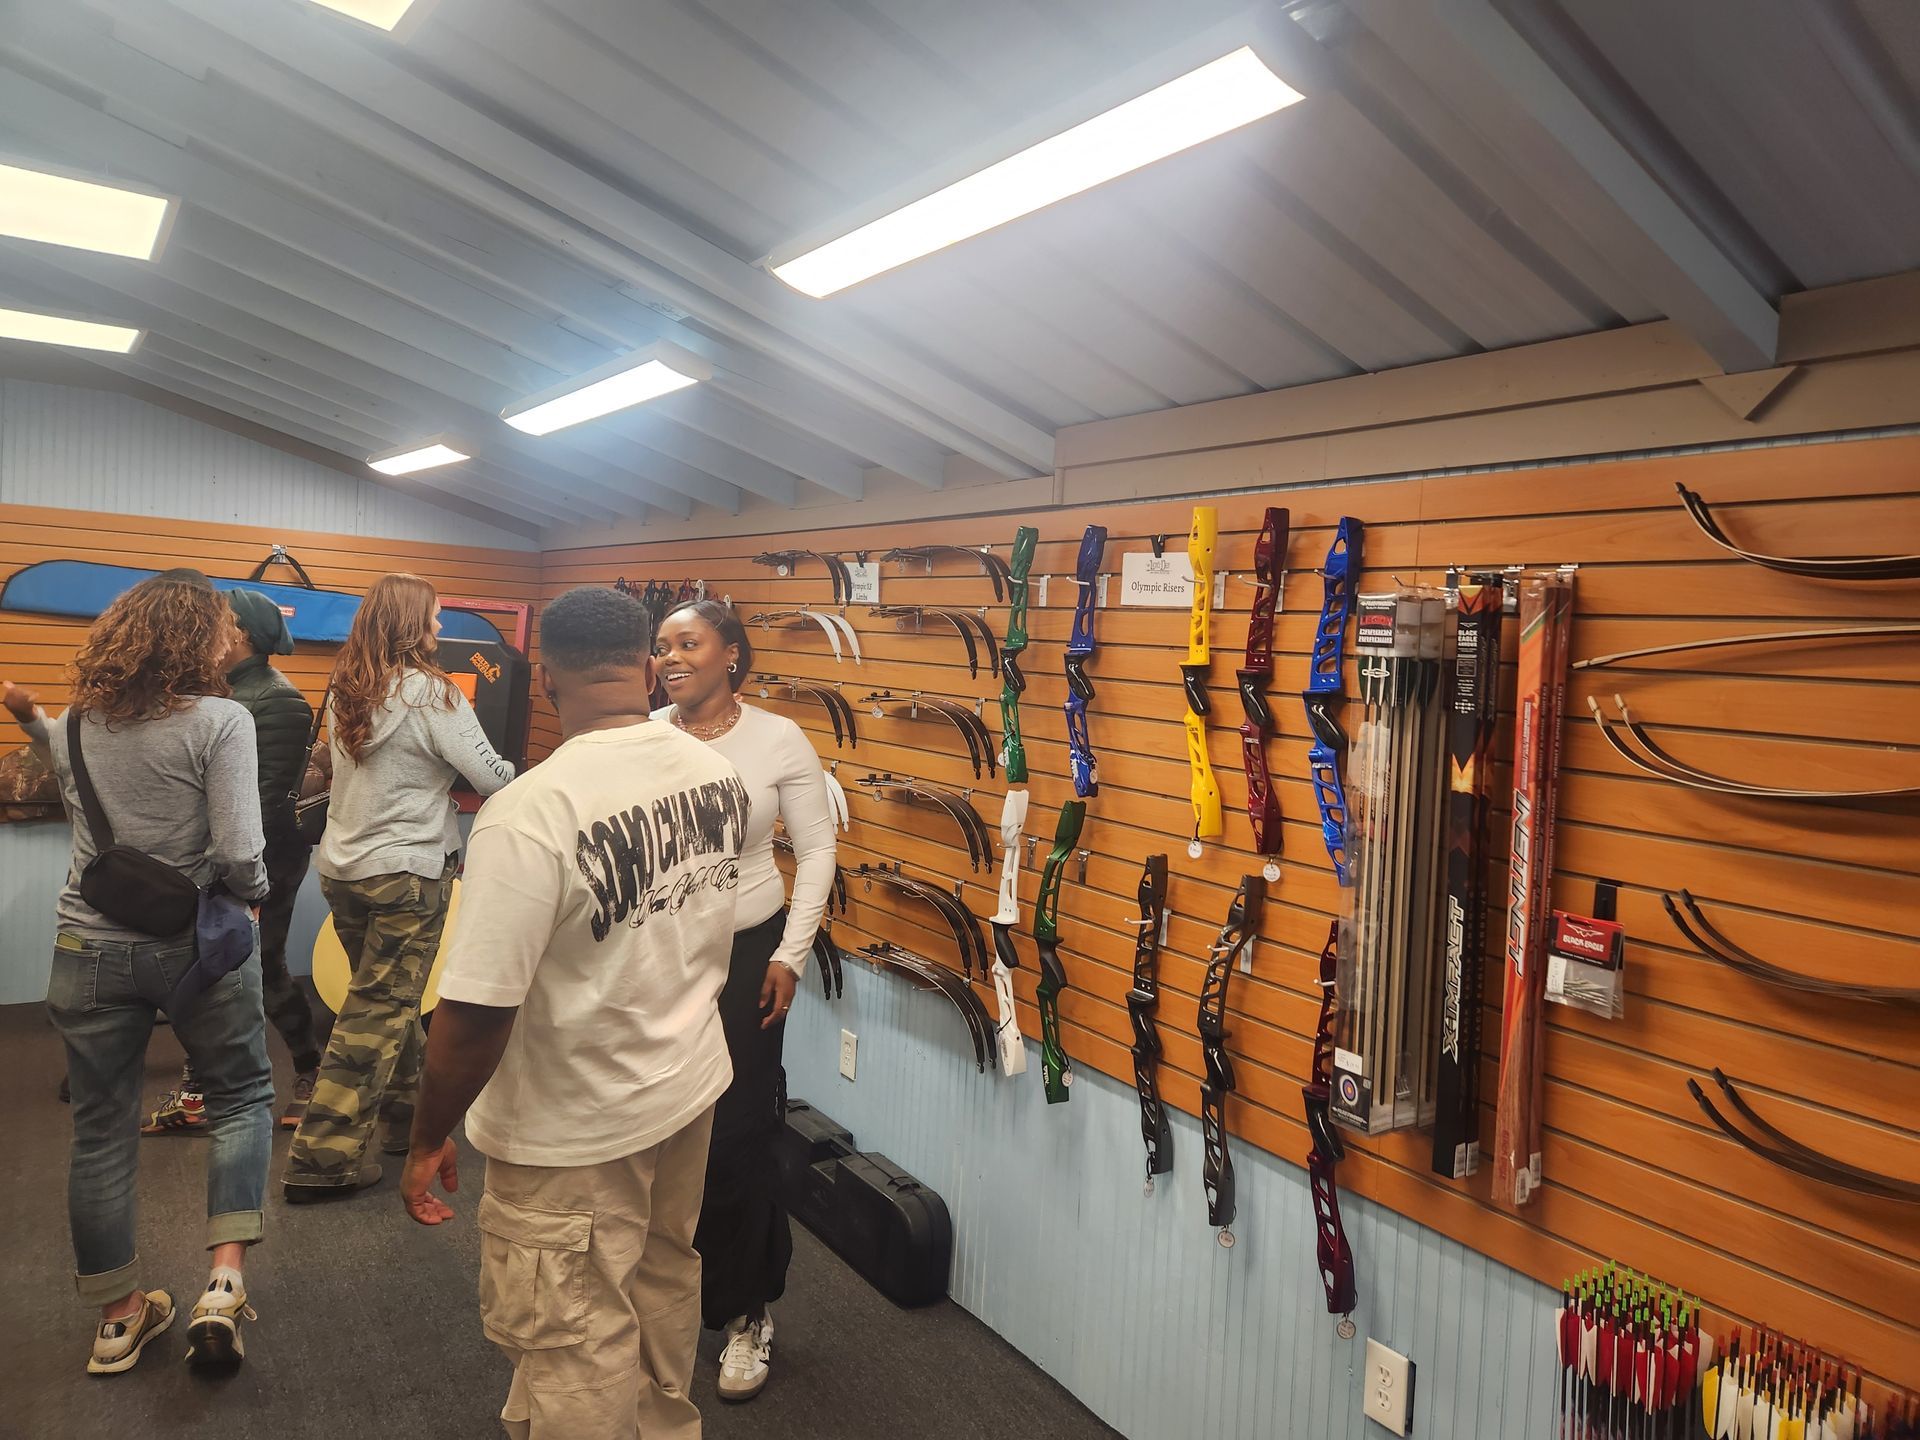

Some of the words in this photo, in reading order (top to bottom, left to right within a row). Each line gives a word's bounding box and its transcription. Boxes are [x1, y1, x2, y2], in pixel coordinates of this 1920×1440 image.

[1131, 581, 1162, 594] Olympic
[1163, 583, 1185, 593] Risers
[1457, 635, 1478, 643] EAGLE
[576, 804, 655, 943] SOHO
[1507, 787, 1531, 979] INSTINCT
[1442, 894, 1464, 1065] X-IMPACT
[1562, 934, 1585, 946] BLACK
[1584, 940, 1605, 953] EAGLE
